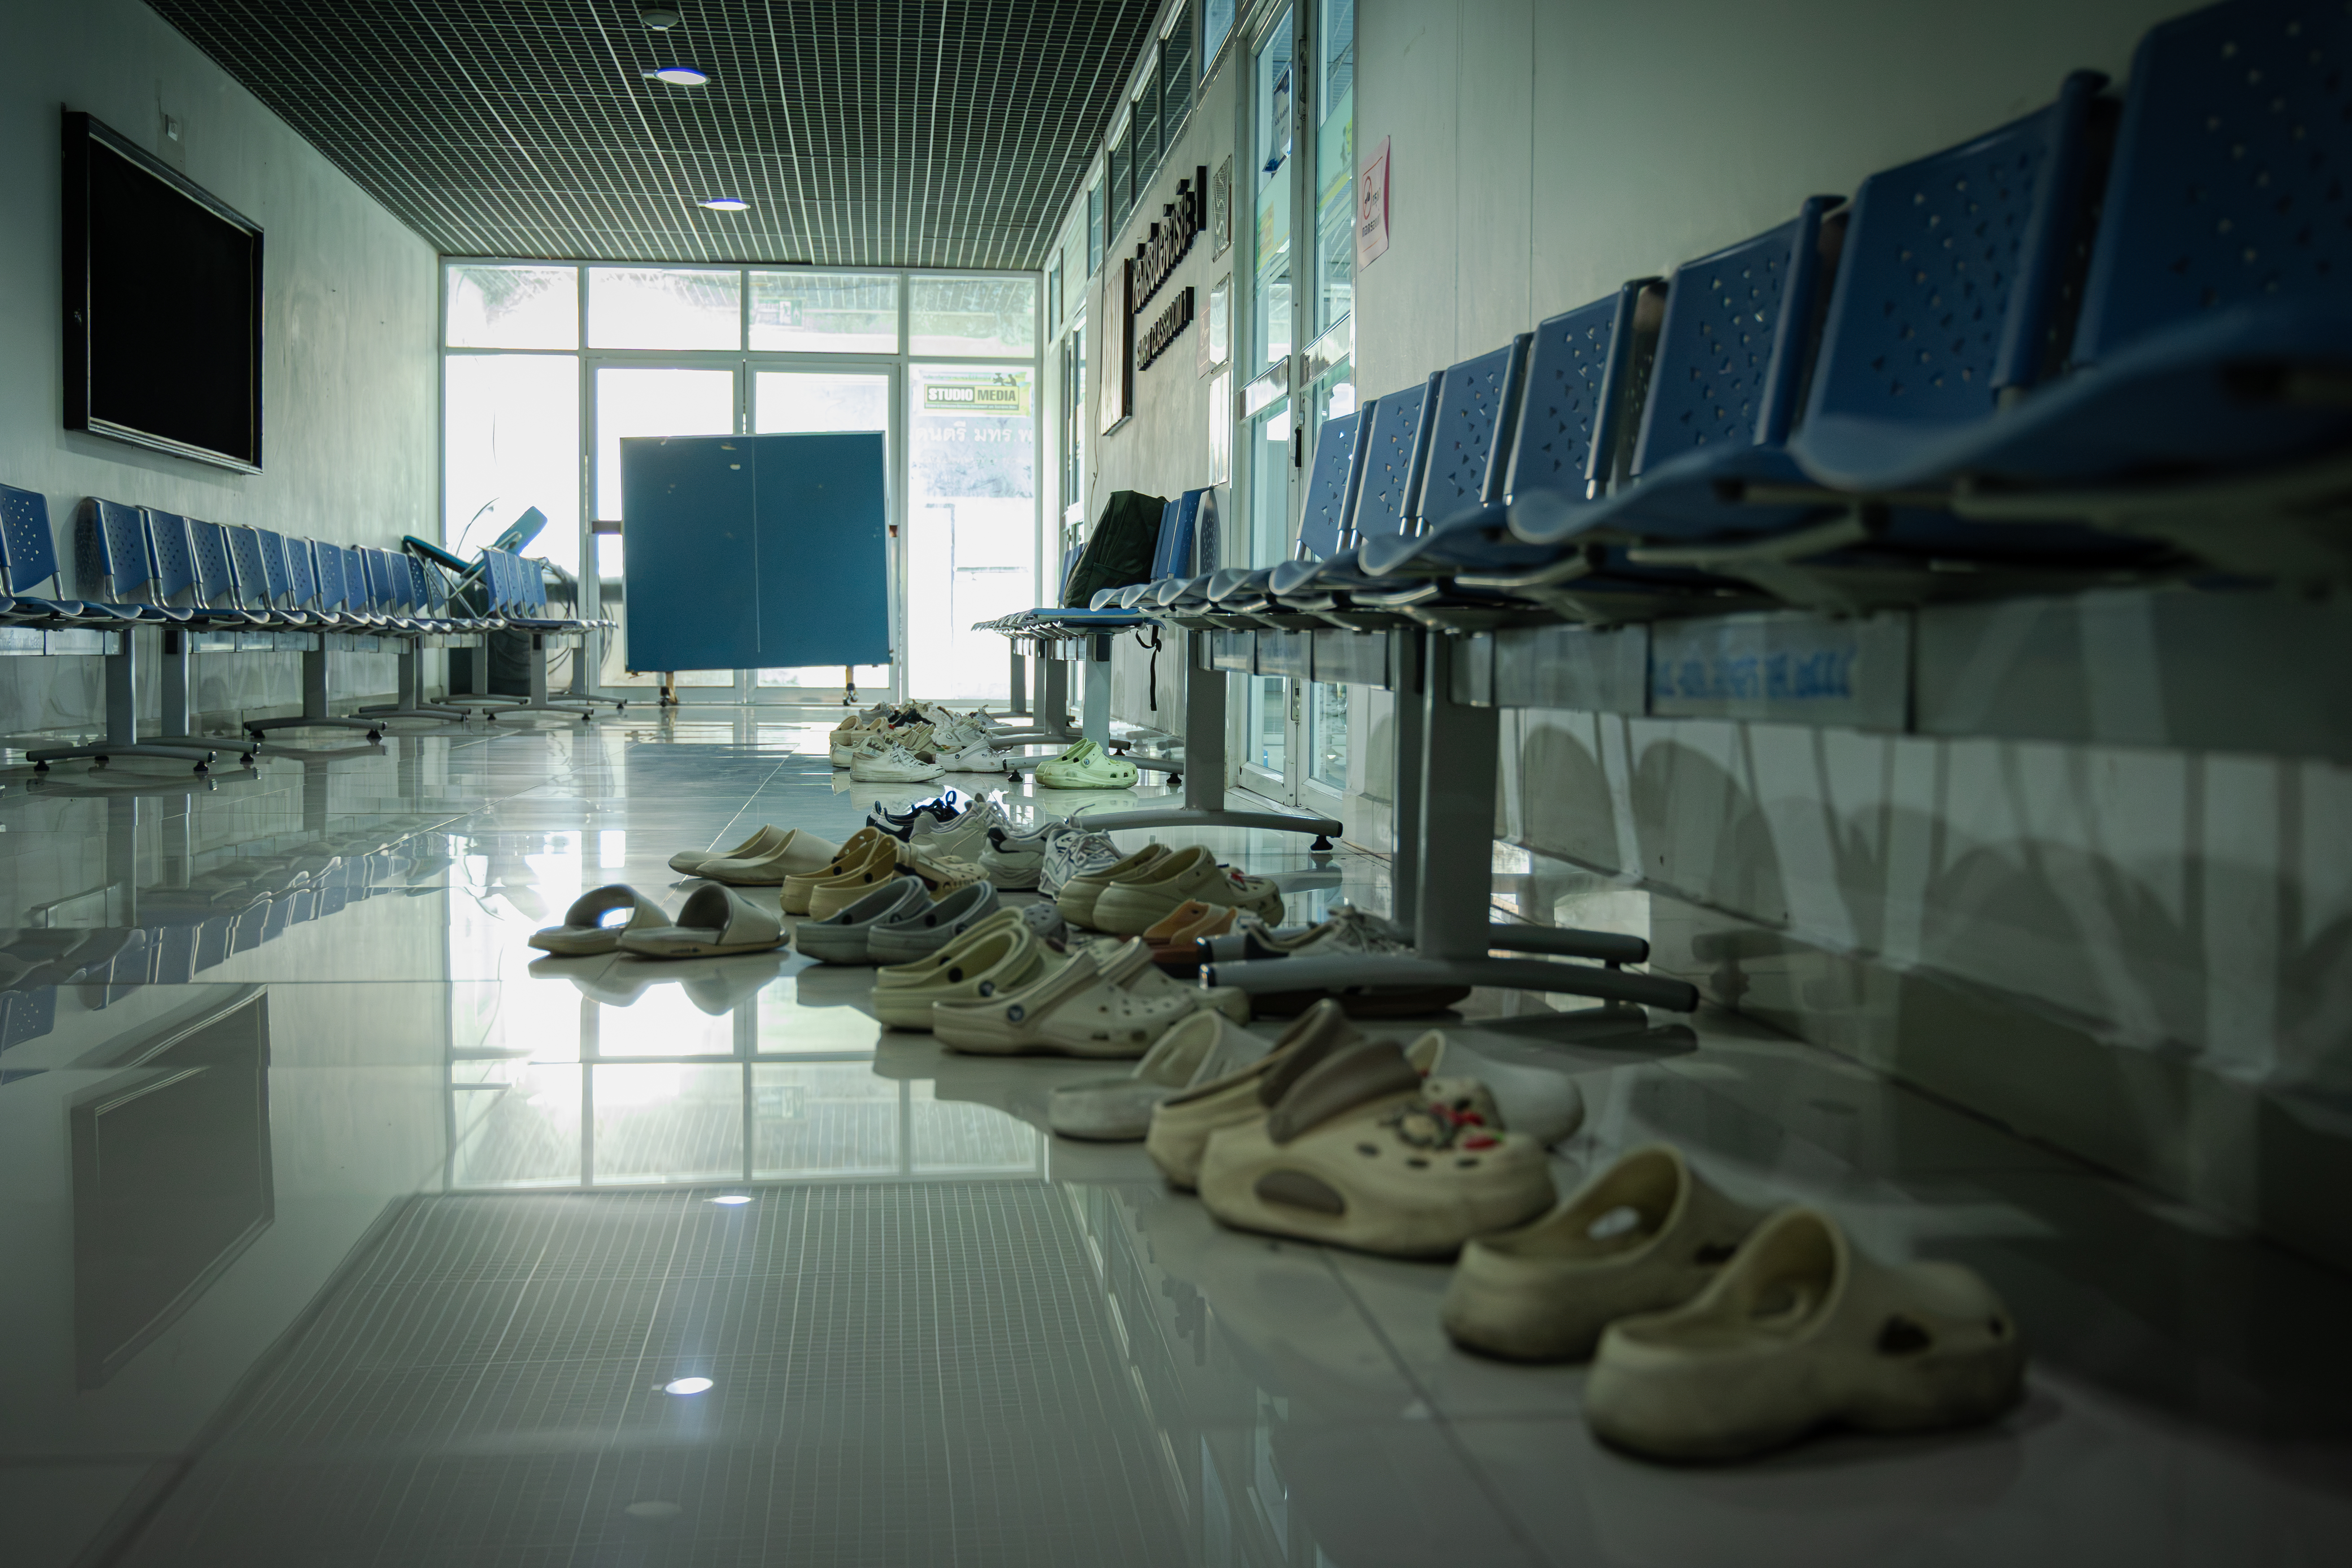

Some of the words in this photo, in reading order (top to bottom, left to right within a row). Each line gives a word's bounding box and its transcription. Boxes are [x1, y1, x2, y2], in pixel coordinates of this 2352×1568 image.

[1137, 327, 1153, 370] SMART
[1151, 291, 1185, 356] CLASSROOM
[928, 388, 974, 401] STUDIO
[977, 389, 1016, 401] MEDIA
